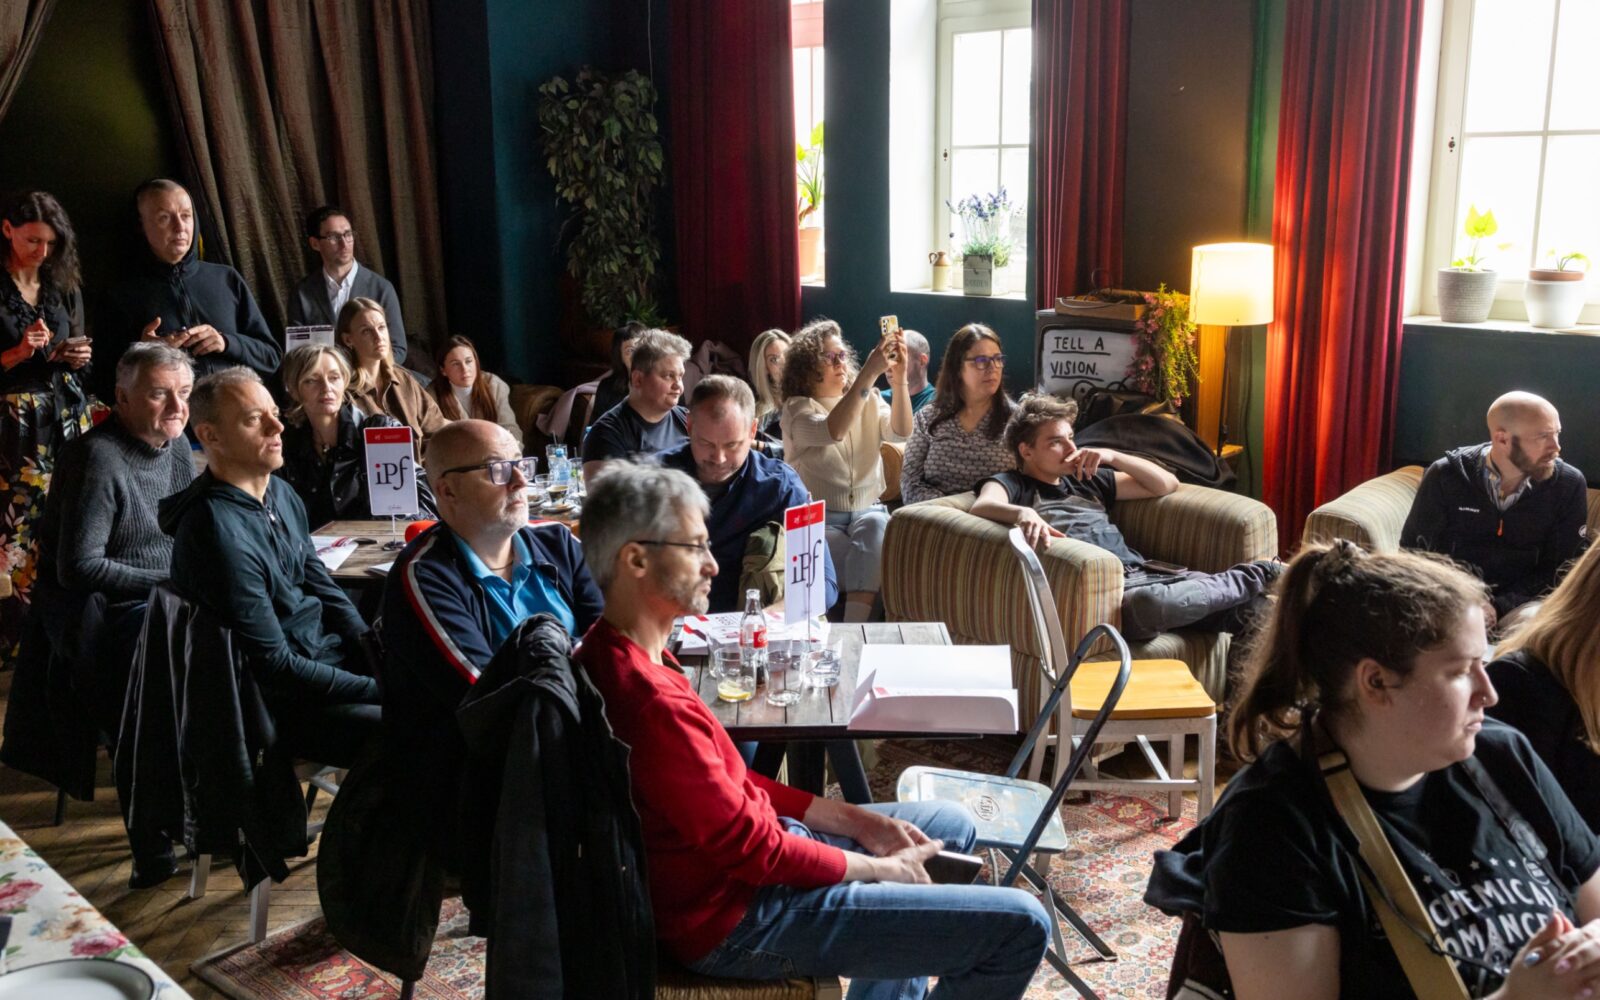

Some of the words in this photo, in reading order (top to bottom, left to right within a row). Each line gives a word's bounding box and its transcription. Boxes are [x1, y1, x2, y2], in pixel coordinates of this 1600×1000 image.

[1053, 336, 1084, 350] TELL
[1094, 336, 1105, 351] A
[1050, 360, 1099, 376] VISION.
[1429, 878, 1557, 928] CHEMICAL
